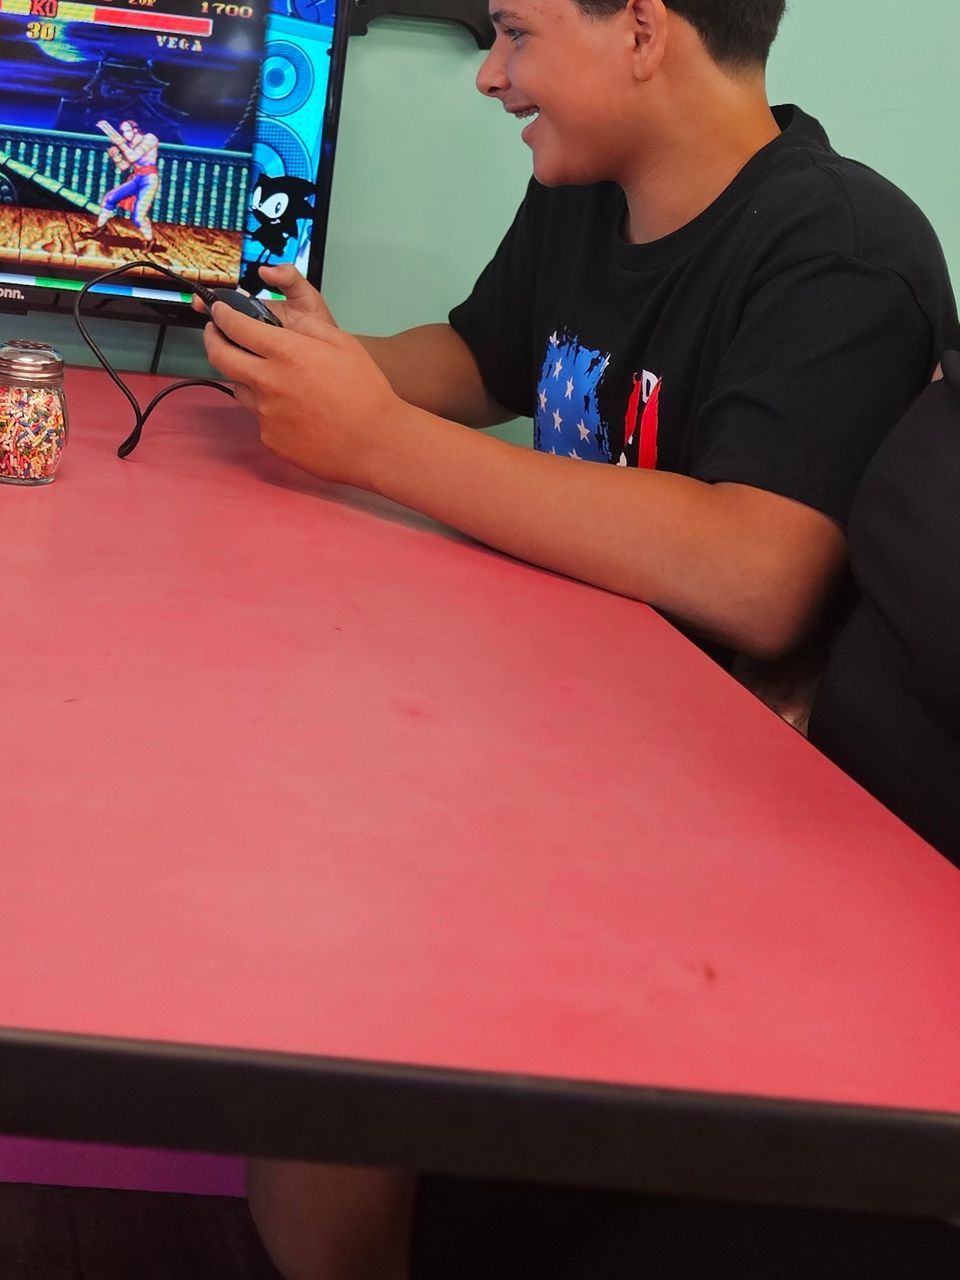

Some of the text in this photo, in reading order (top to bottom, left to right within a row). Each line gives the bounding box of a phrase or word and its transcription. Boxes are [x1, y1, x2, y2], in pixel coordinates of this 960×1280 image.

[200, 1, 254, 19] 1700
[26, 22, 56, 41] 30
[155, 35, 203, 53] VEGA
